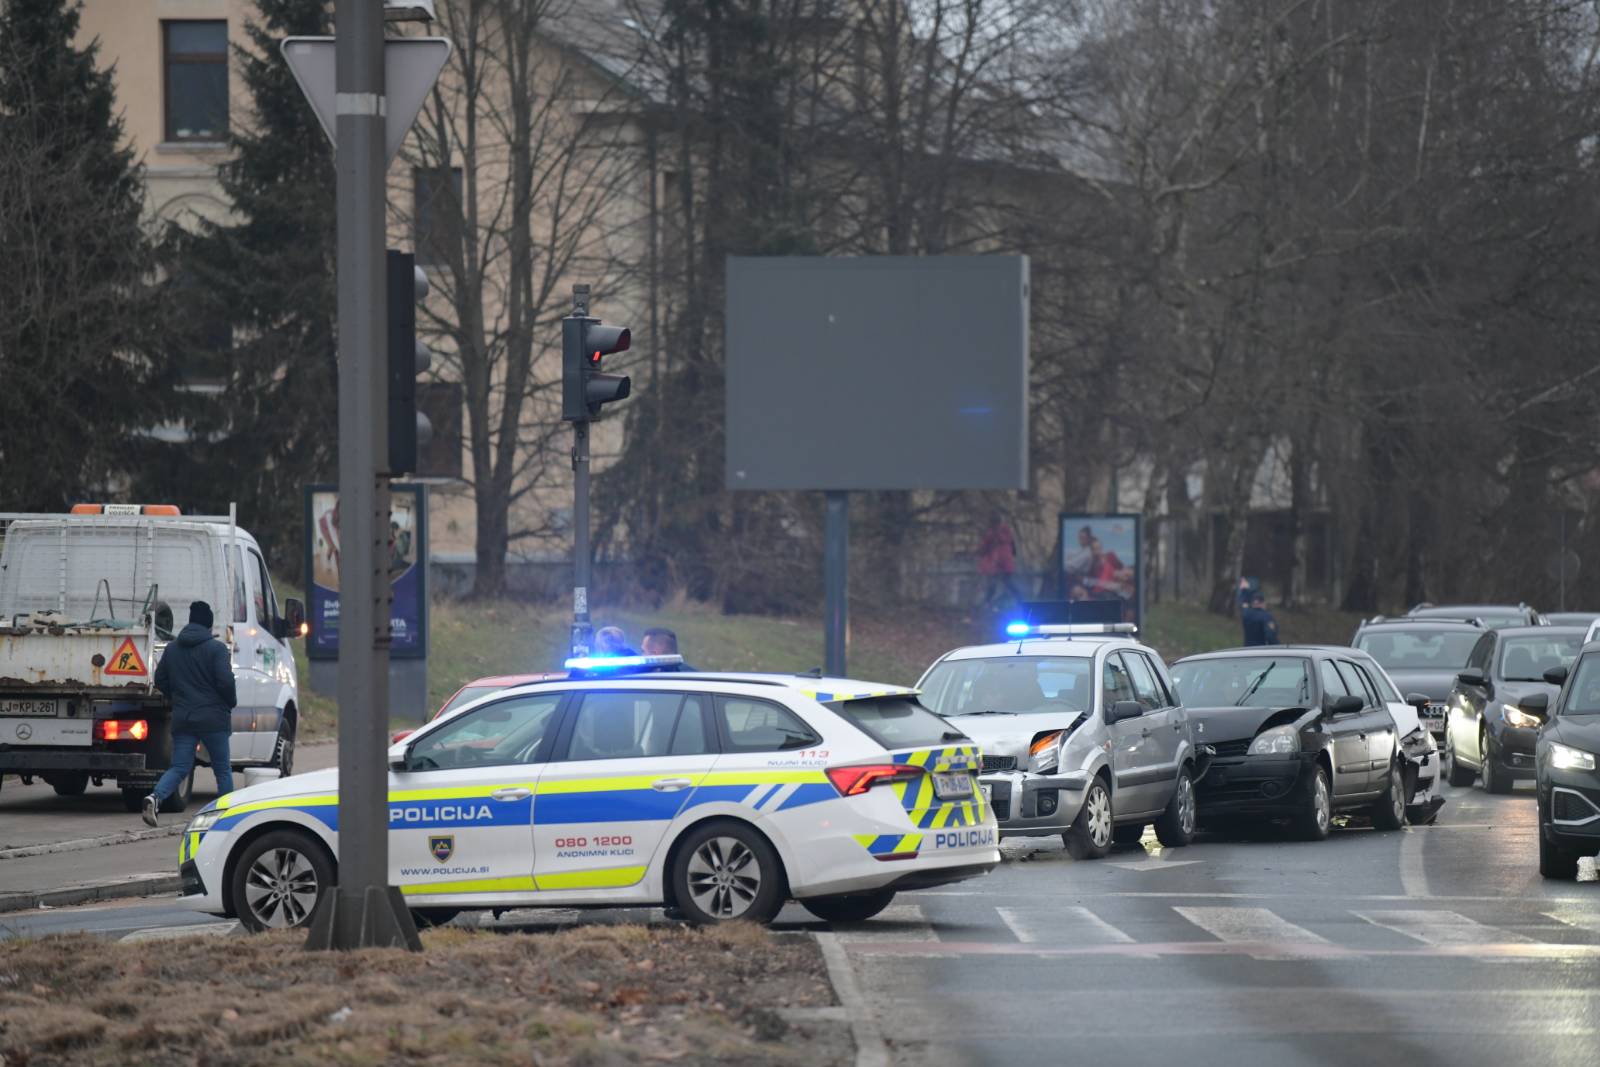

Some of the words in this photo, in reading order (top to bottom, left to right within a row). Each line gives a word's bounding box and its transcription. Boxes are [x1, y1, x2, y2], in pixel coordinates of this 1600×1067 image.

[799, 750, 830, 758] 113
[389, 805, 493, 822] POLICIJA
[555, 837, 587, 848] 080
[592, 836, 632, 847] 1200
[935, 829, 994, 849] POLICIJA
[556, 849, 608, 858] ANONIMNI
[609, 848, 634, 856] KLICI
[400, 866, 490, 876] WWW.POLICIJA.SI
